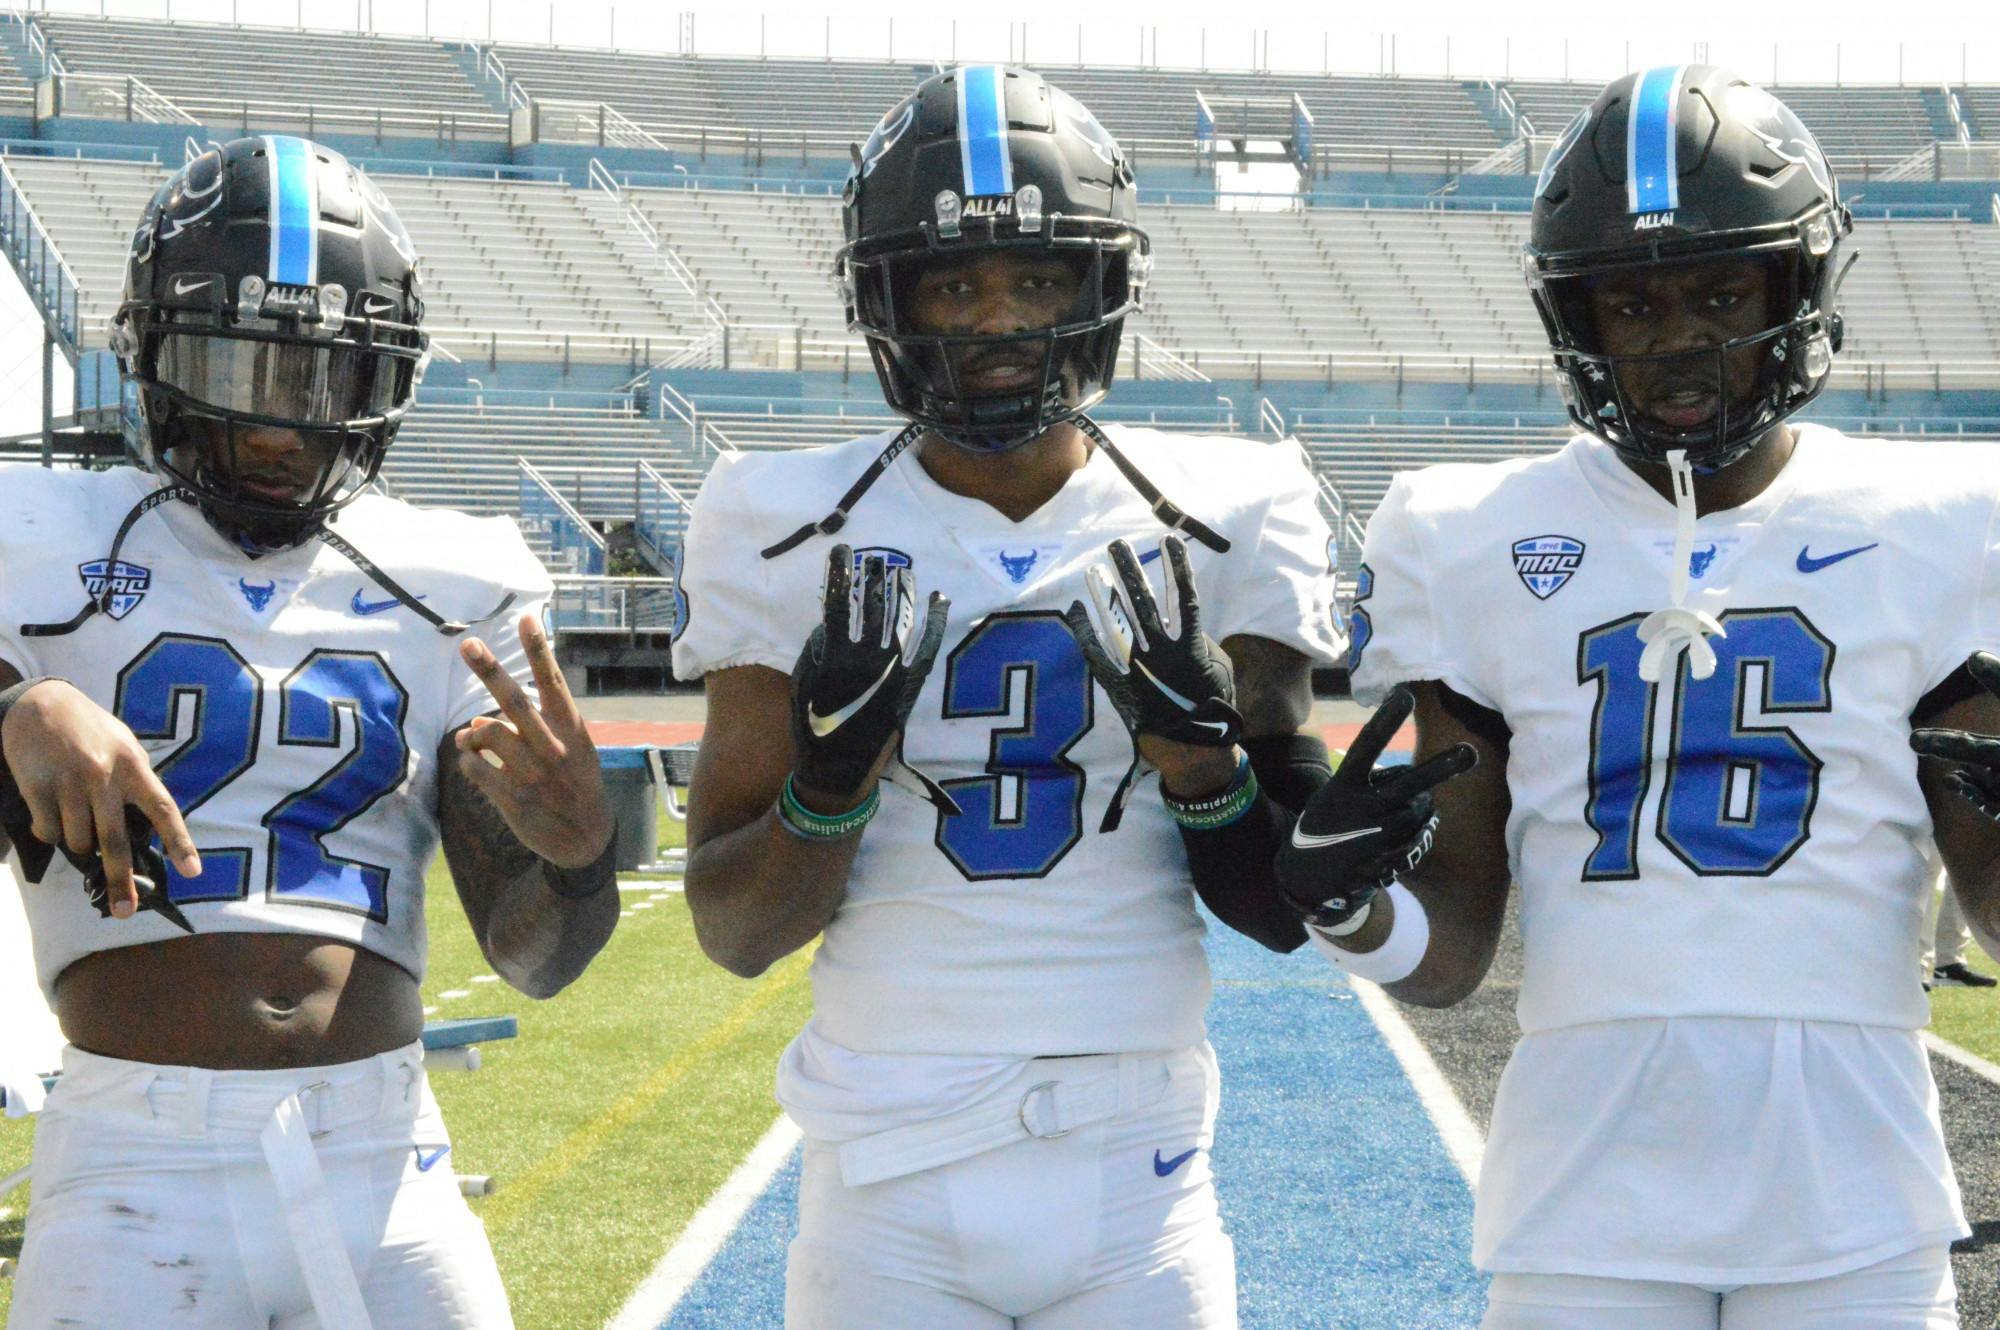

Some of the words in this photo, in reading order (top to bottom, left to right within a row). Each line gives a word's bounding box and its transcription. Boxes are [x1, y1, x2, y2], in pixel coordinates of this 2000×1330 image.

[140, 487, 186, 514] SPORT
[1516, 555, 1579, 573] MAC
[112, 631, 410, 925] 22
[941, 609, 1095, 882] 3
[1576, 606, 1837, 883] 16
